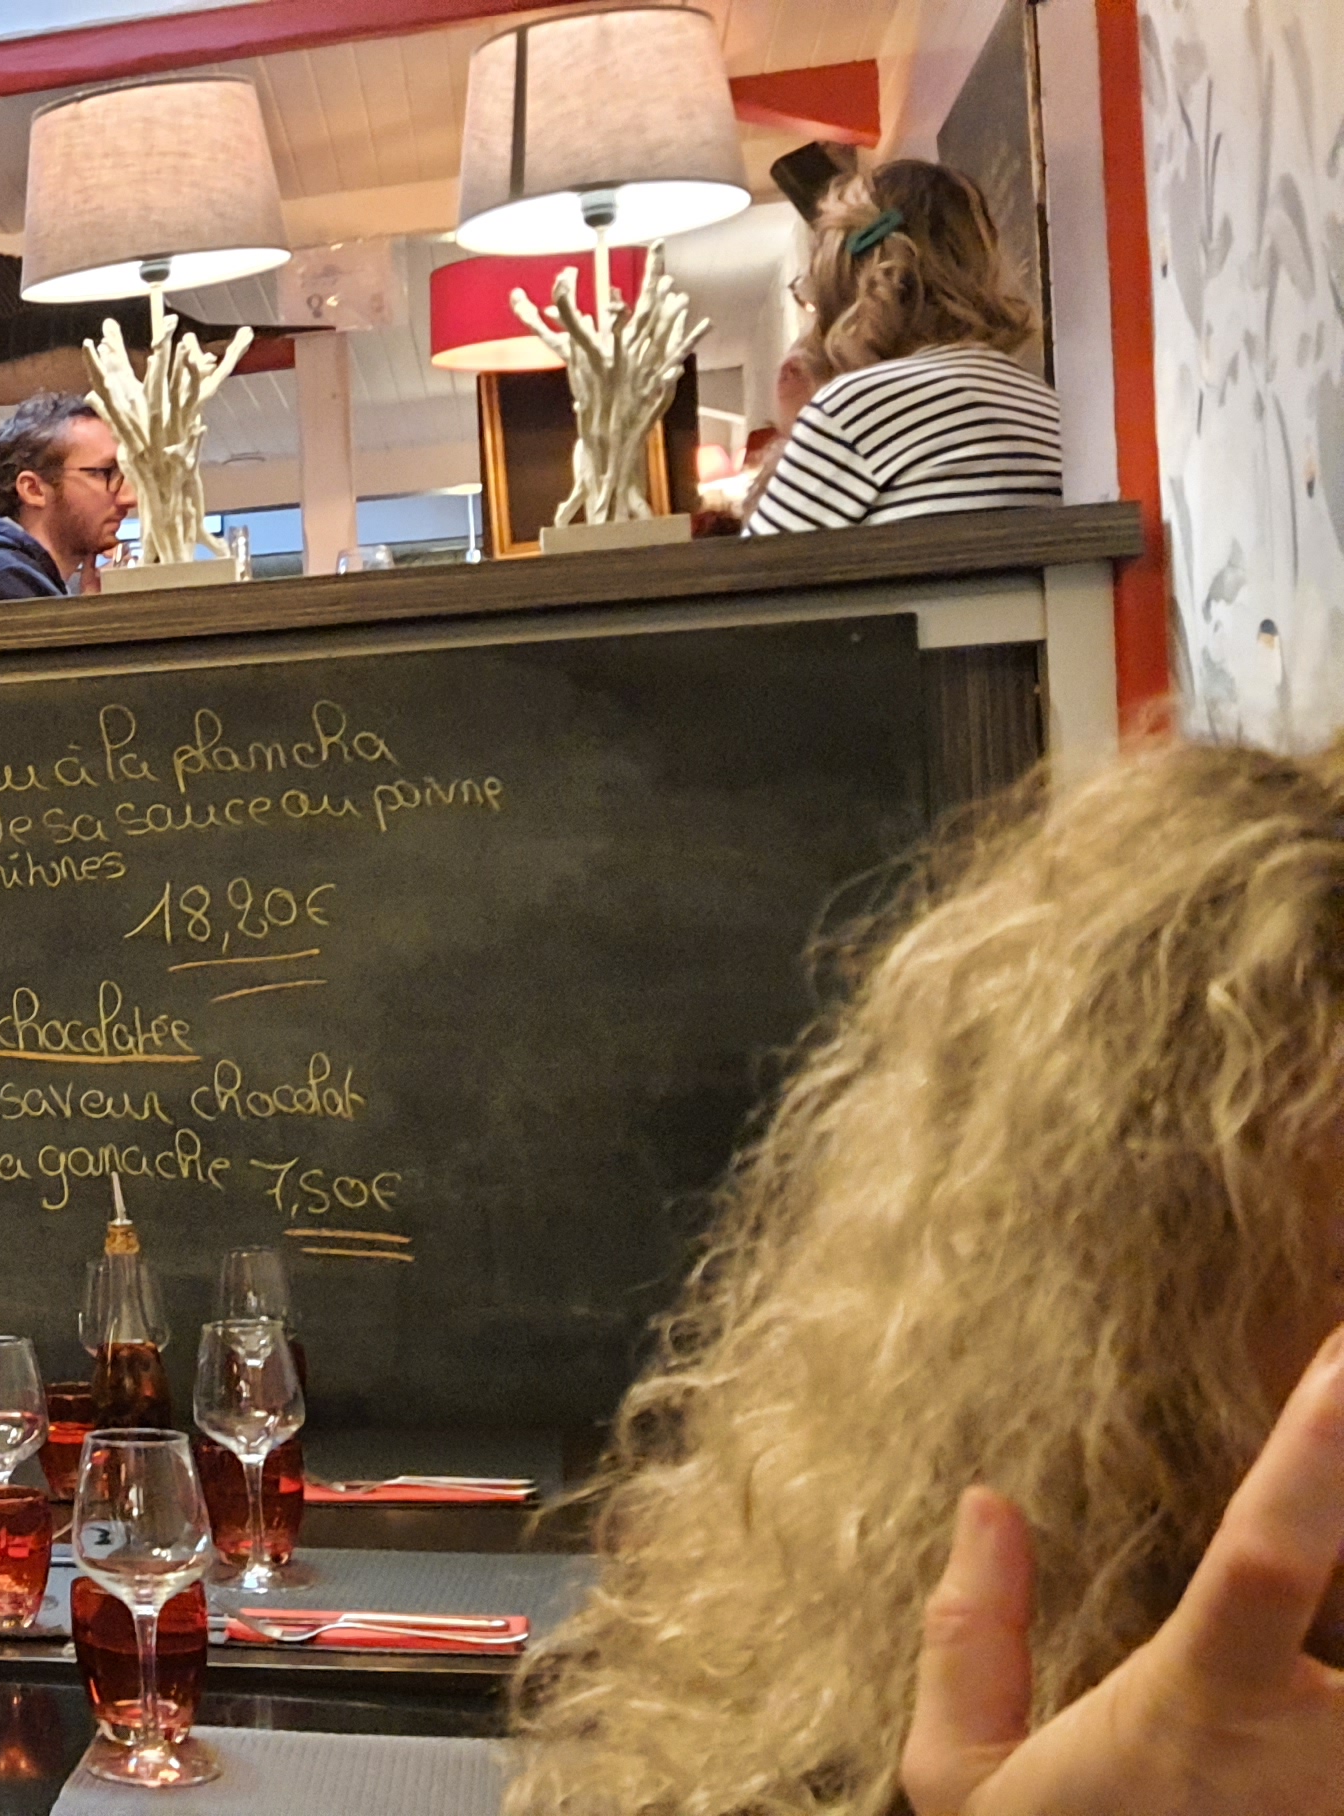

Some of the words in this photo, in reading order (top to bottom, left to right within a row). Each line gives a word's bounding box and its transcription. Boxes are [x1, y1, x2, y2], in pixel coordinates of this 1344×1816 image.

[54, 744, 100, 787] à
[99, 703, 160, 782] la
[173, 700, 399, 793] plancha
[42, 807, 113, 845] sa
[115, 795, 273, 836] sauce
[280, 787, 365, 821] au
[123, 876, 338, 954] 18,20€
[0, 1080, 174, 1125] saveur
[191, 1051, 368, 1122] chocolat
[38, 1127, 230, 1210] ganache
[249, 1156, 402, 1219] 7,50€
